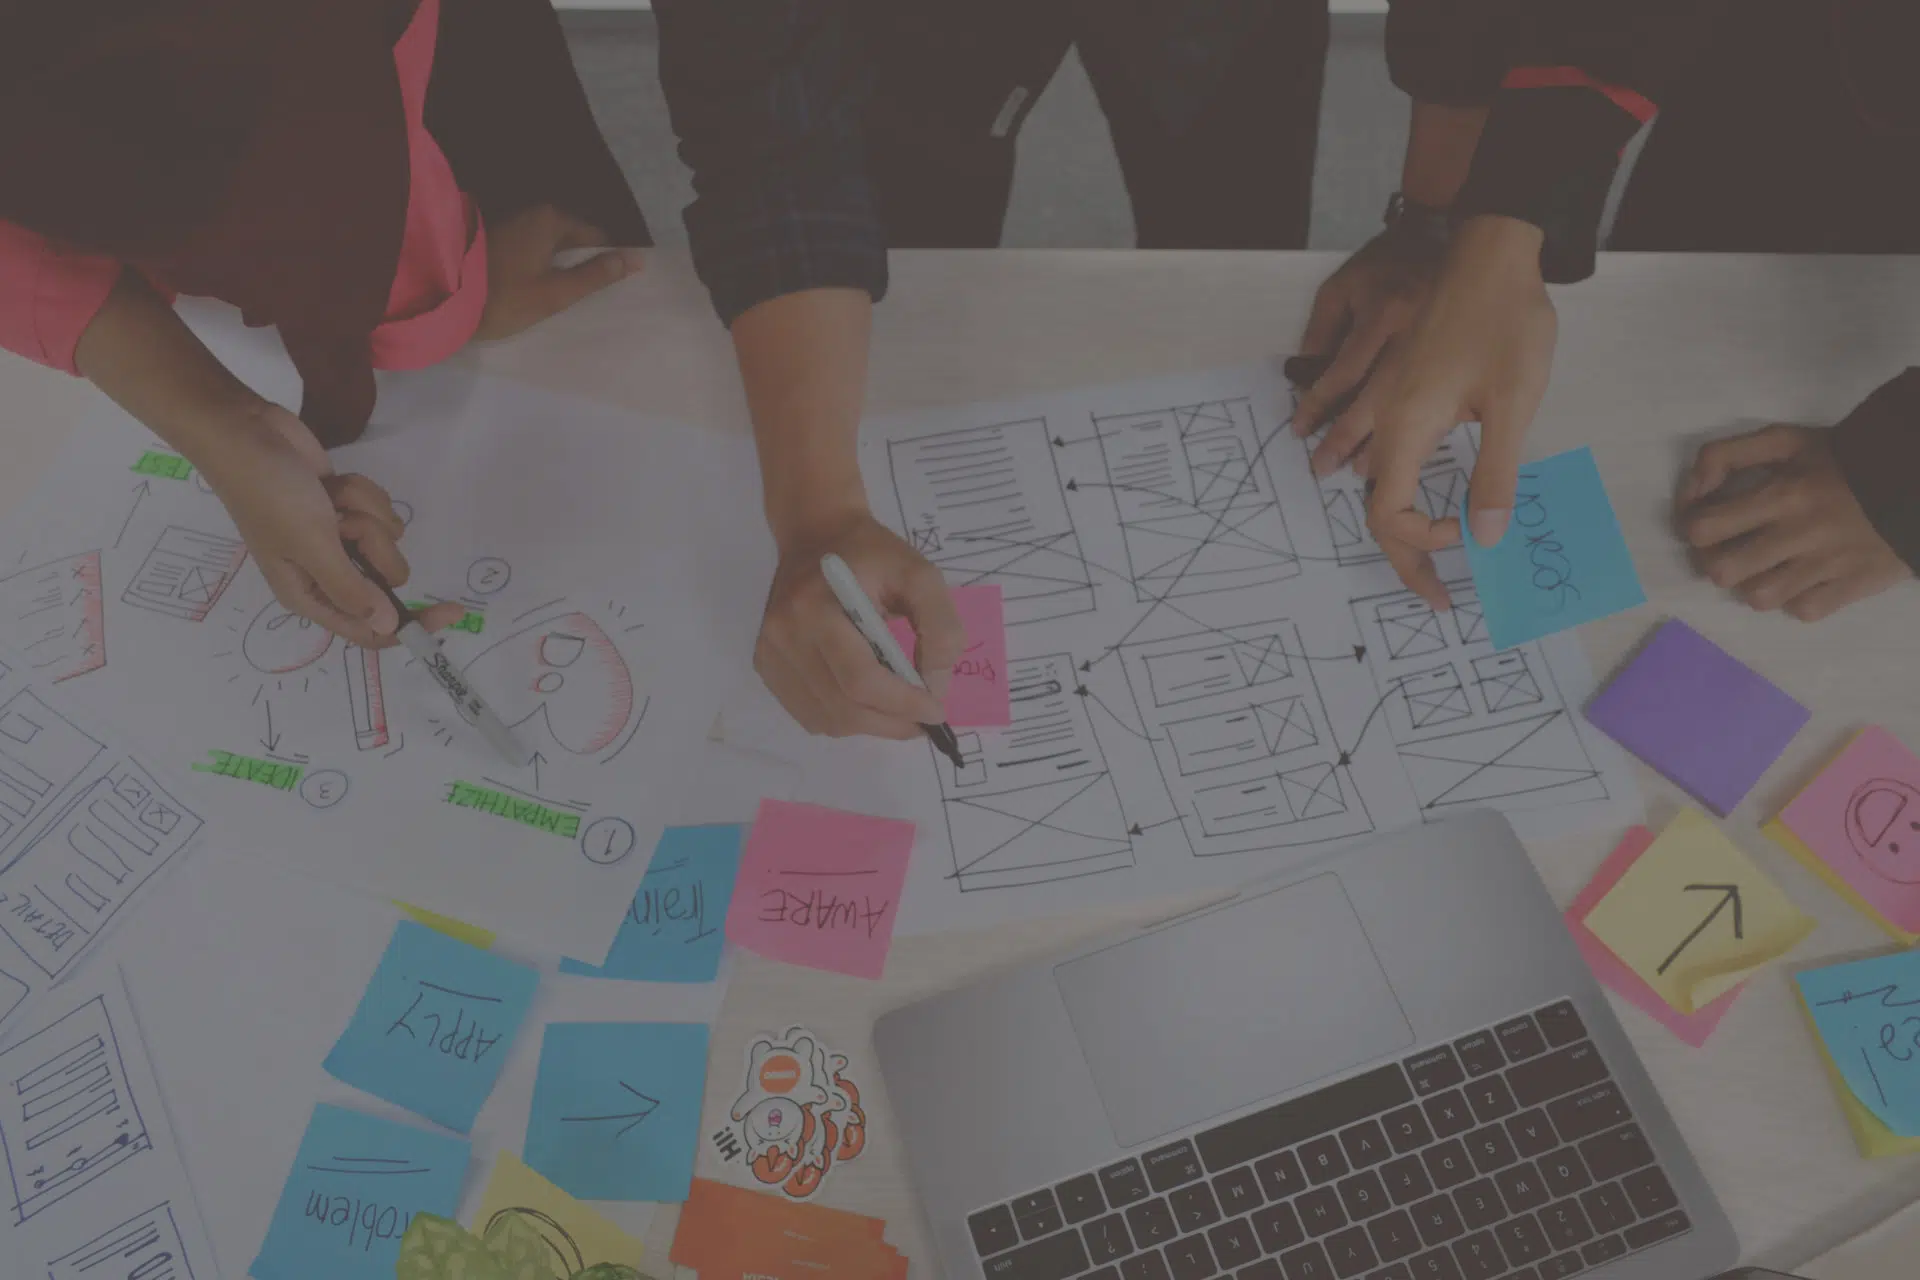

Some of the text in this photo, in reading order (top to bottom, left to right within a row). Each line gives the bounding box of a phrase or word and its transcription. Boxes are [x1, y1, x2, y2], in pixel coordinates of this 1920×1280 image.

[480, 567, 500, 584] 2
[318, 782, 333, 800] 3
[441, 783, 581, 839] EMPATHIZE
[625, 879, 717, 944] Train
[758, 888, 889, 940] AWARE
[385, 991, 504, 1064] APPLY
[1410, 1052, 1448, 1070] command
[1484, 1091, 1495, 1104] Z
[1443, 1107, 1457, 1120] X
[1401, 1122, 1413, 1135] C
[1525, 1126, 1536, 1140] A
[712, 1125, 742, 1162] HI!
[1361, 1139, 1371, 1151] V
[1484, 1140, 1496, 1155] S
[1149, 1145, 1189, 1165] command
[1316, 1152, 1329, 1166] B
[1442, 1157, 1456, 1169] D
[1109, 1163, 1135, 1178] option
[1274, 1168, 1287, 1182] N
[1403, 1175, 1411, 1189] F
[1230, 1184, 1244, 1200] M
[1358, 1189, 1369, 1202] G
[1313, 1205, 1328, 1217] H
[1556, 1207, 1568, 1225] 2
[303, 1189, 410, 1252] roblem
[1302, 1163, 1572, 1275] Q W E R T Y U
[1512, 1226, 1524, 1239] 3
[1228, 1236, 1241, 1249] K
[1471, 1244, 1480, 1256] 4
[1185, 1253, 1196, 1265] L
[1427, 1259, 1441, 1272] 5
